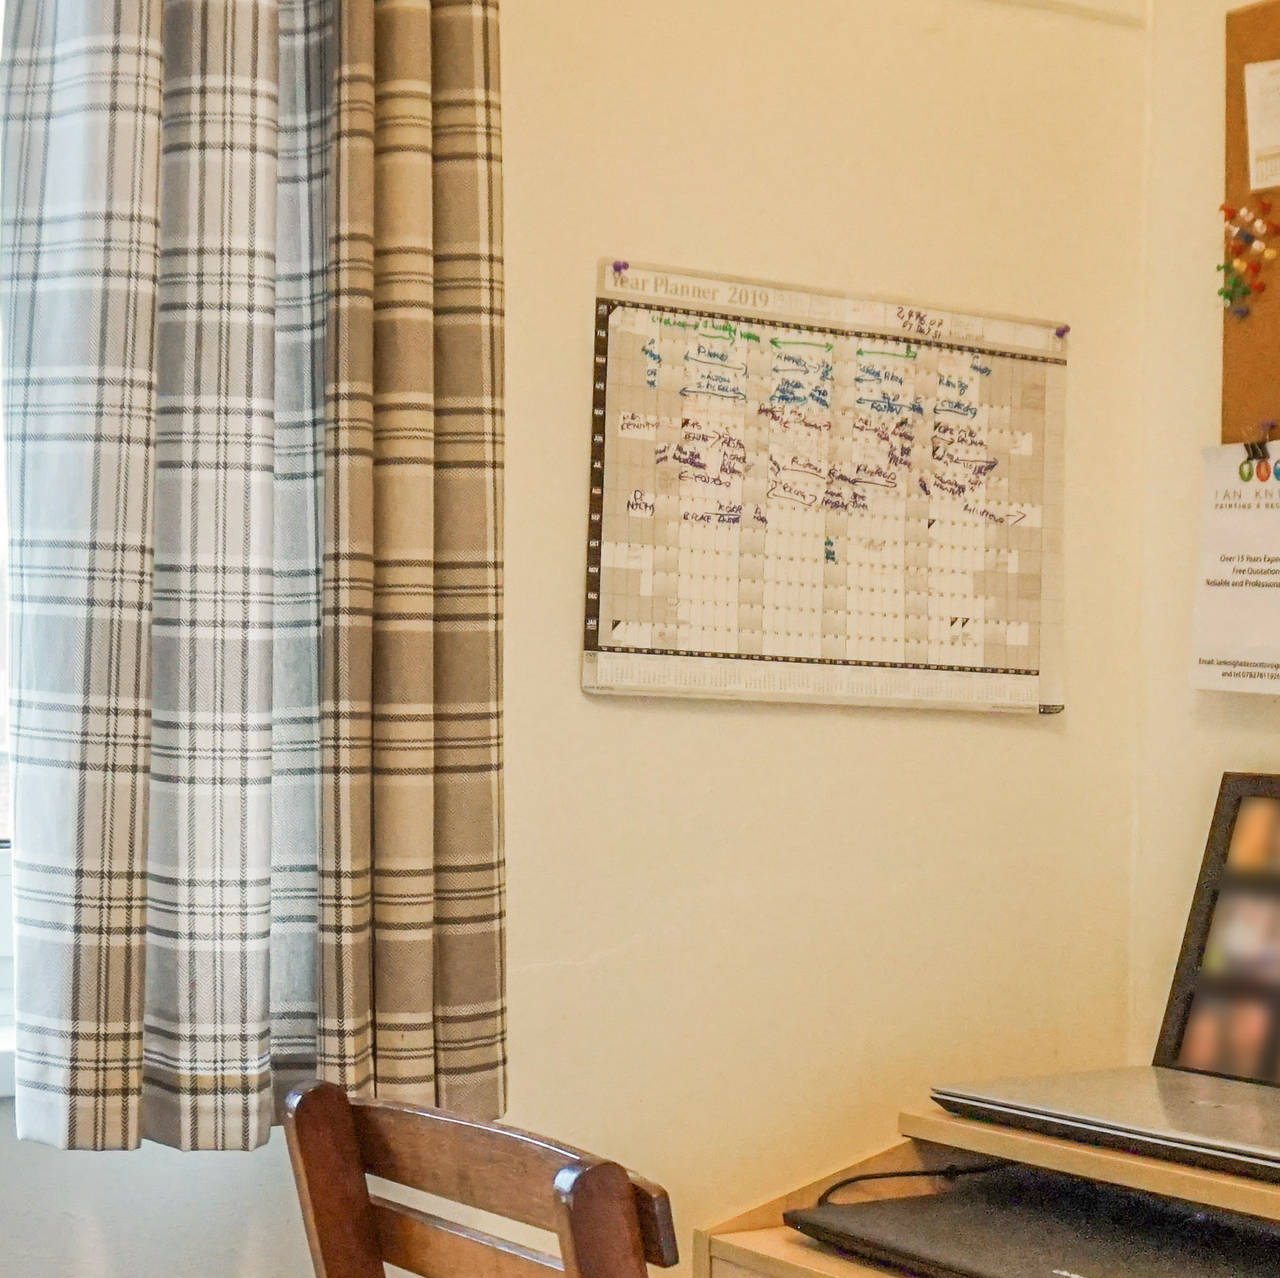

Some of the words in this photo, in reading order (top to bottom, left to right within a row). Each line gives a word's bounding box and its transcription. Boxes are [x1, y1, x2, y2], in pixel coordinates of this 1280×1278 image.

[611, 270, 648, 292] Year
[653, 275, 720, 302] Planner
[727, 286, 770, 307] 2019
[1219, 554, 1235, 563] Over
[1232, 566, 1246, 575] Free
